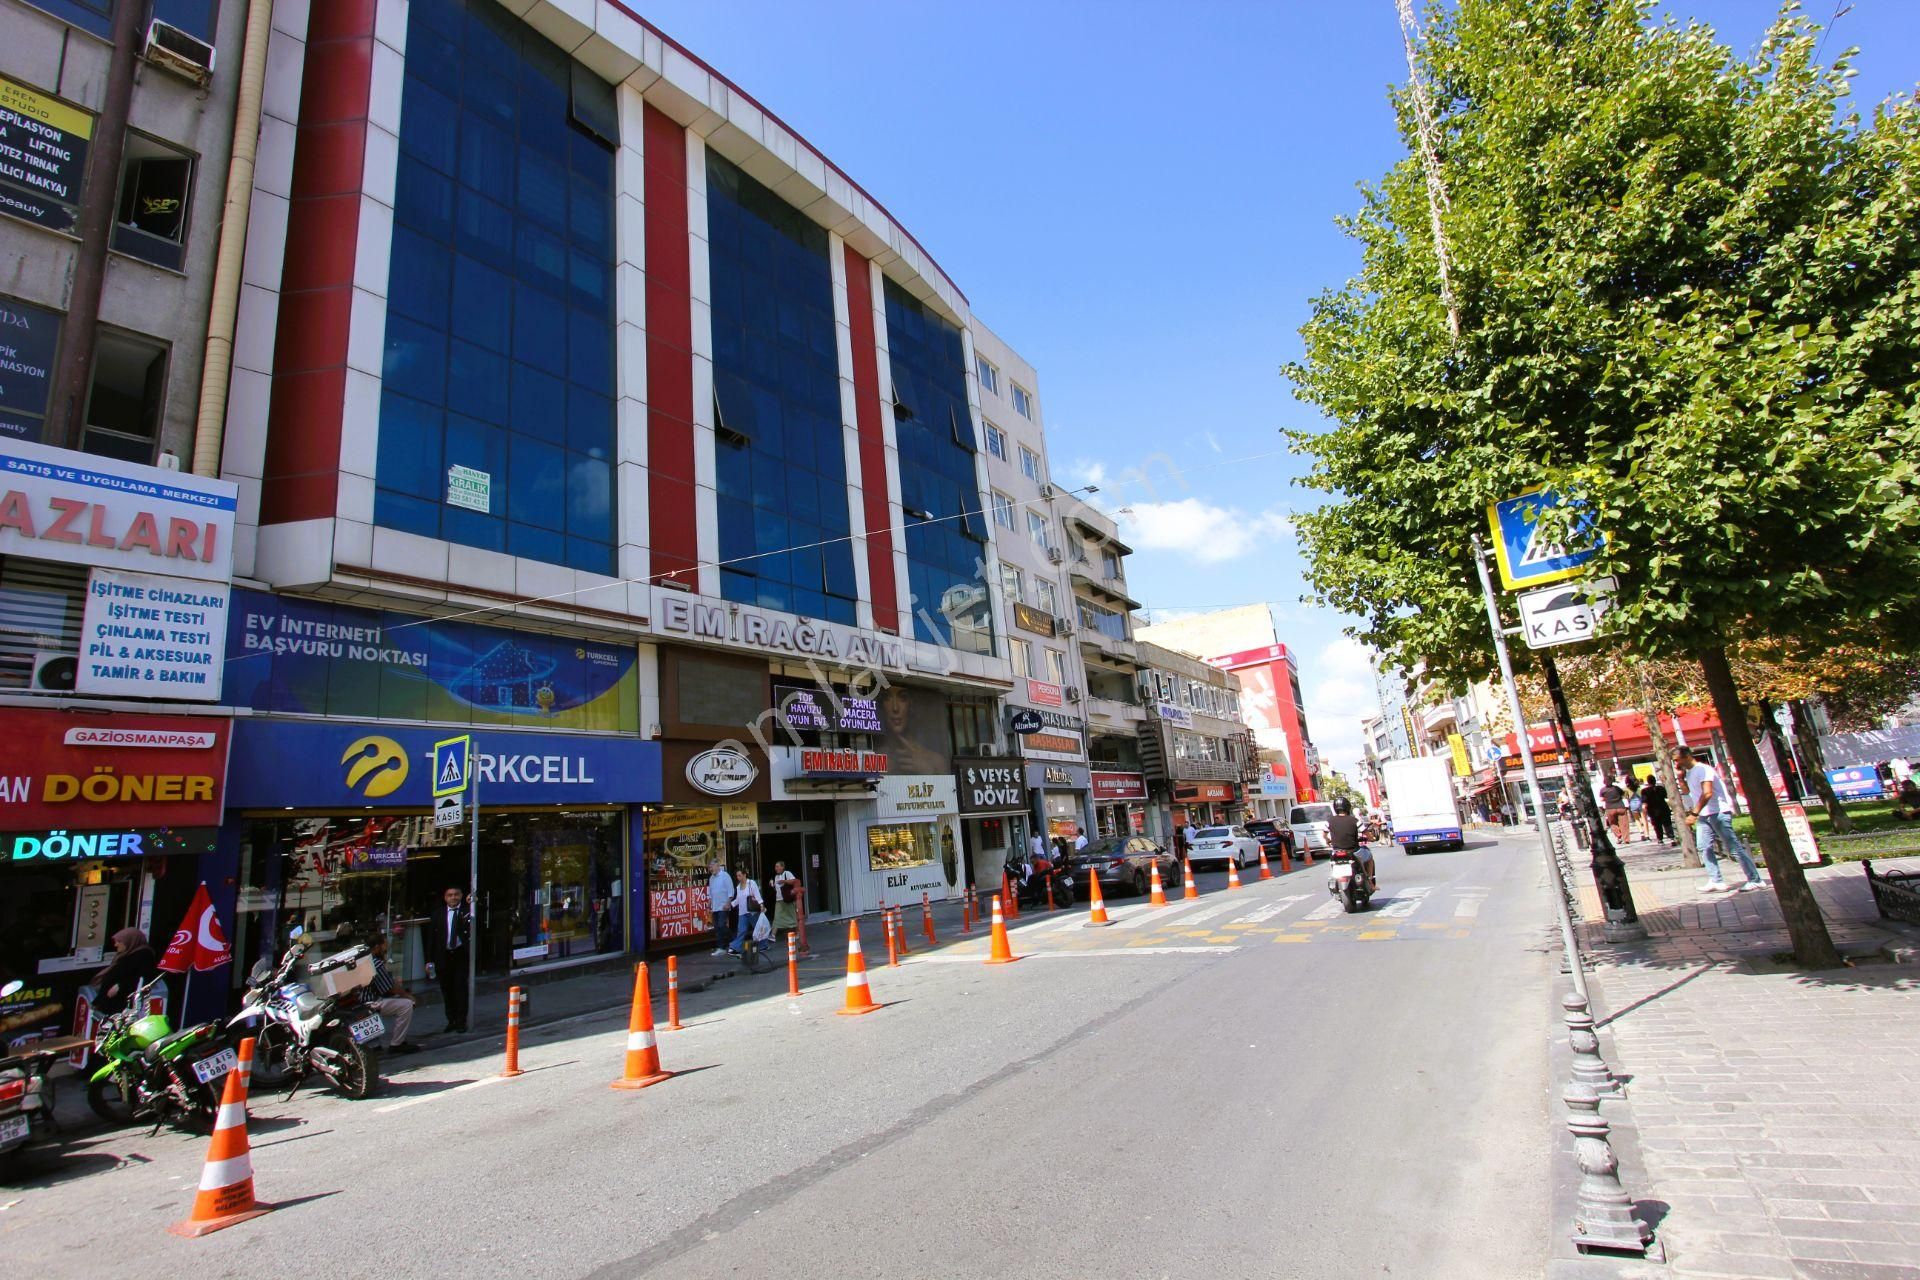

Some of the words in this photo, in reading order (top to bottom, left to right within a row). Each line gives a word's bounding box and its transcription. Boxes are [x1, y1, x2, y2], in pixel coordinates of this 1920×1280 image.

[1, 94, 49, 119] STUDIO
[0, 109, 62, 142] EPİLASYON
[29, 138, 71, 161] LIFTING
[25, 153, 60, 174] TIRNAK
[26, 172, 67, 197] MAKYAJ
[8, 460, 52, 476] SATIŞ
[56, 470, 75, 480] VE
[81, 474, 157, 495] UYGULAMA
[163, 489, 219, 506] MERKEZİ
[0, 490, 217, 563] AZLARI
[91, 580, 144, 599] İŞİTME
[148, 588, 224, 609] CİHAZLARI
[108, 602, 160, 621] İŞİTME
[164, 611, 205, 626] TESTİ
[1531, 608, 1606, 639] KASİ
[96, 623, 166, 642] ÇINLAMA
[170, 629, 211, 646] TESTİ
[246, 613, 275, 631] EV
[281, 615, 382, 644] İNTERNETİ
[664, 598, 841, 658] EMİRAĞA
[845, 635, 901, 669] AVM
[89, 643, 115, 658] PİL
[118, 647, 131, 659] &
[134, 648, 213, 665] AKSESUAR
[244, 633, 343, 658] BAŞVURU
[348, 645, 428, 667] NOKTASI
[587, 651, 618, 663] TURKCELL
[91, 664, 141, 681] TAMİR
[144, 671, 155, 681] &
[159, 671, 207, 684] BAKIM
[790, 703, 822, 716] HAVUZU
[843, 707, 877, 720] MACERA
[798, 692, 814, 704] TOP
[842, 698, 877, 711] RANLI
[786, 714, 810, 726] OYUN
[840, 717, 881, 731] OYUNLARI
[75, 731, 206, 746] GAZİOSMANPAŞA
[1537, 727, 1602, 746] voone
[711, 755, 737, 770] D&P
[804, 748, 859, 771] EMİRAĞA
[863, 753, 888, 772] AVM
[42, 766, 215, 802] DÖNER
[968, 767, 976, 785] $
[979, 768, 1011, 783] VEYS
[1013, 768, 1021, 782] €
[907, 781, 935, 799] ELİF
[974, 786, 1020, 806] DÖVİZ
[12, 830, 144, 860] DÖNER
[887, 875, 909, 888] ELİF
[655, 889, 686, 907] %50
[661, 920, 681, 938] 270
[364, 1025, 380, 1036] 822
[210, 1063, 227, 1076] 080
